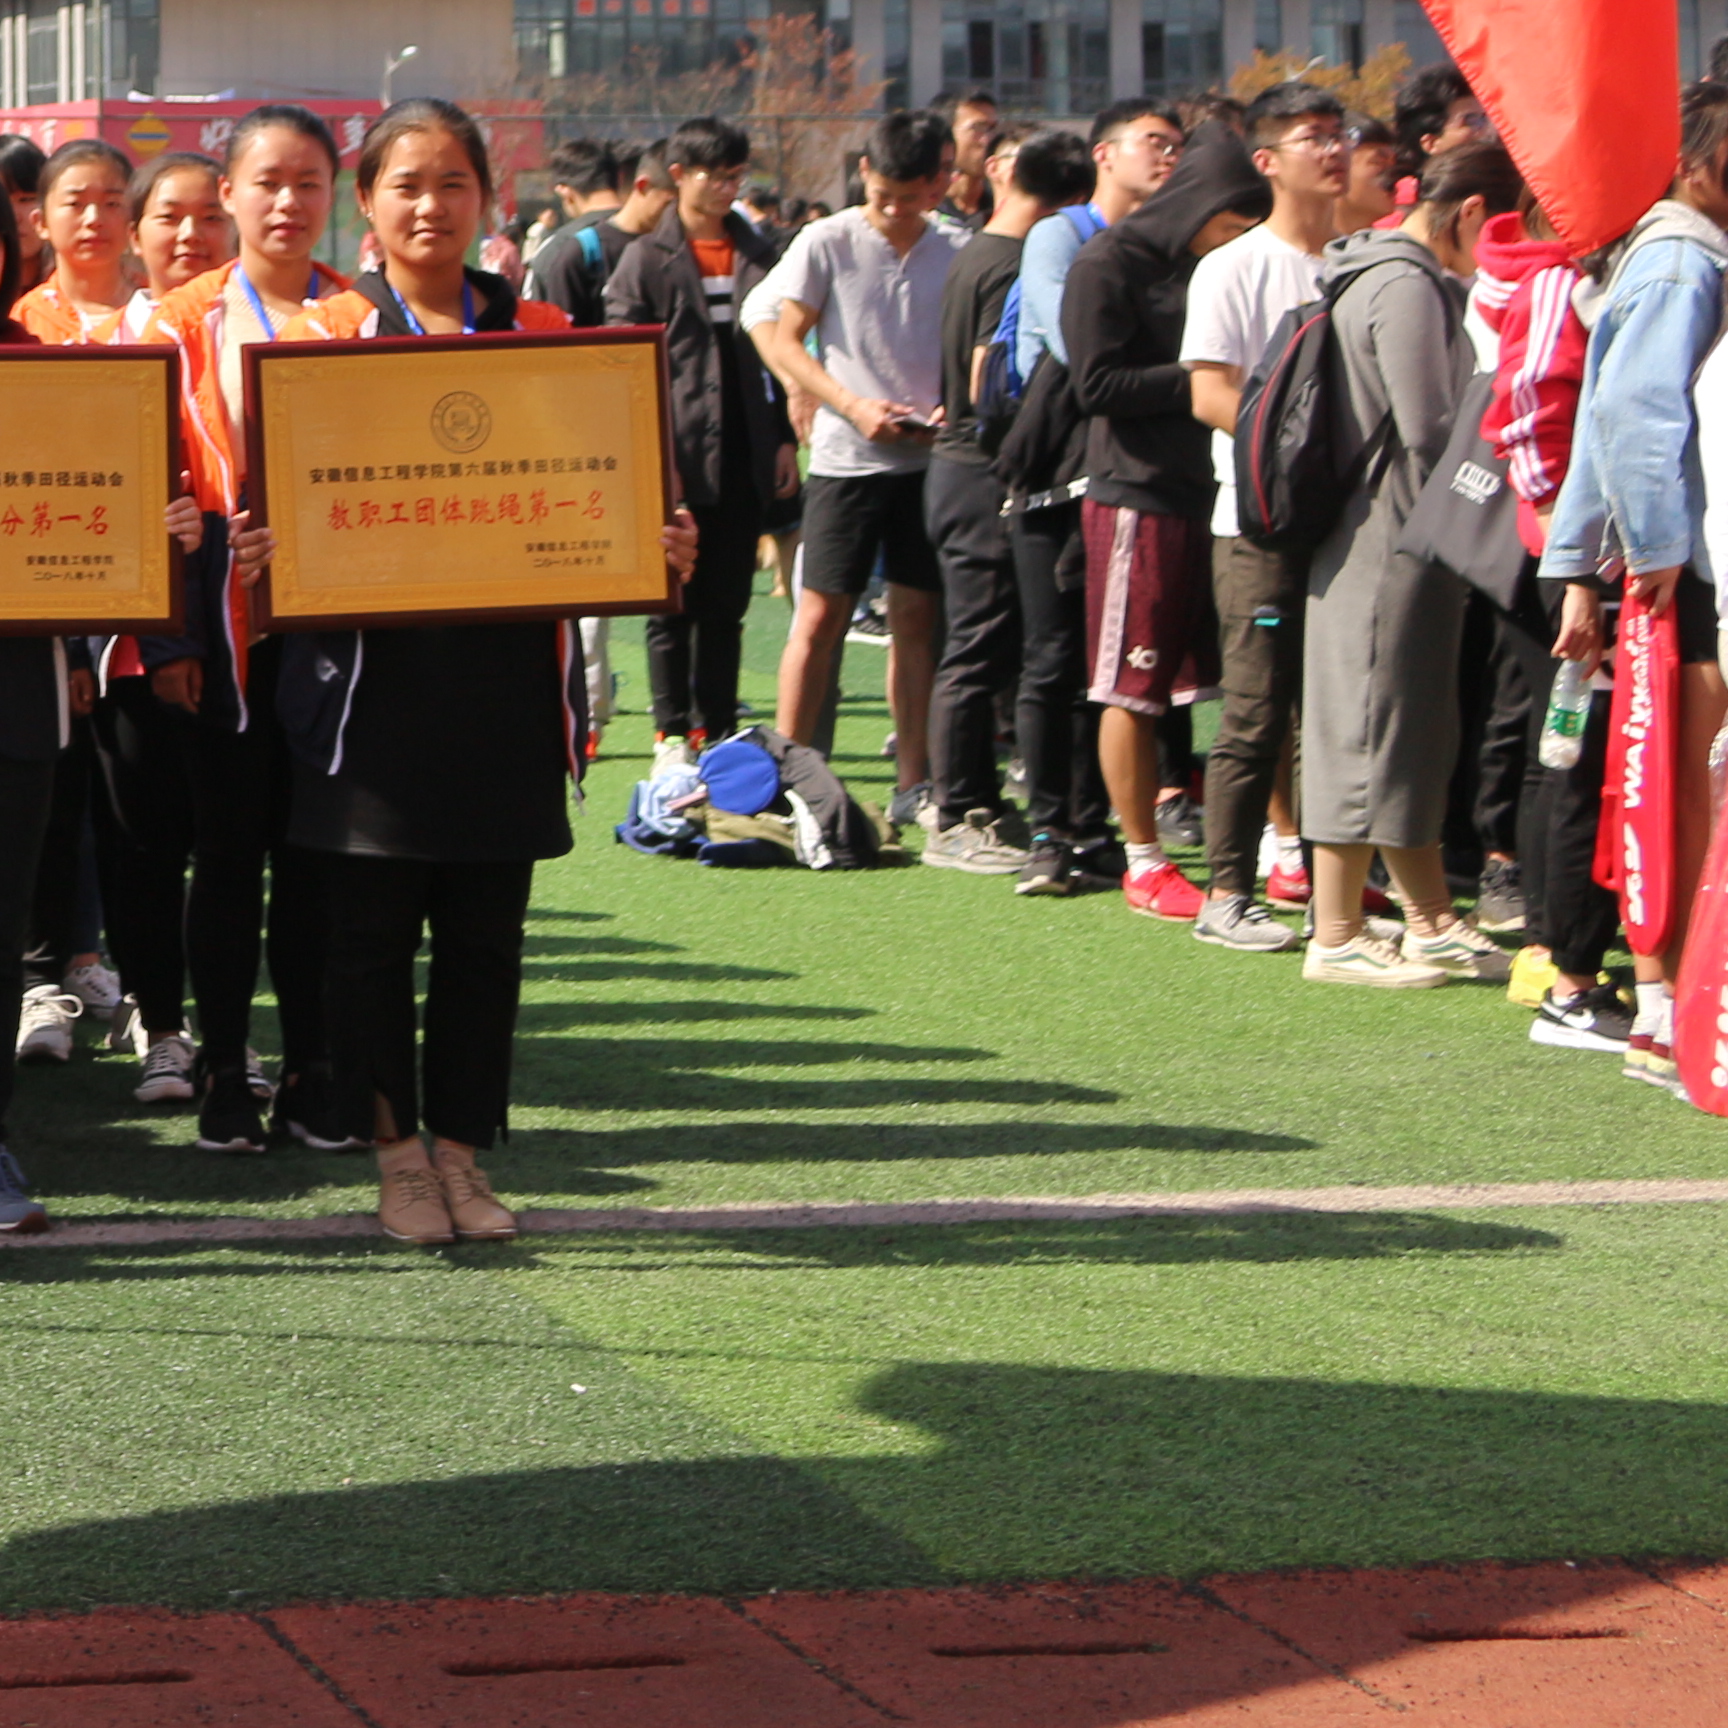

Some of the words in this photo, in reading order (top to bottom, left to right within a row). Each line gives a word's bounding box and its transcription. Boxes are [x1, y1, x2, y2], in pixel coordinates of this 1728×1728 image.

[309, 455, 618, 486] 安徽信息工程学院第六届秋季田径运动会
[326, 488, 607, 532] 教职工团体跳绳第一名
[25, 553, 116, 567] 安徽信息工程学院
